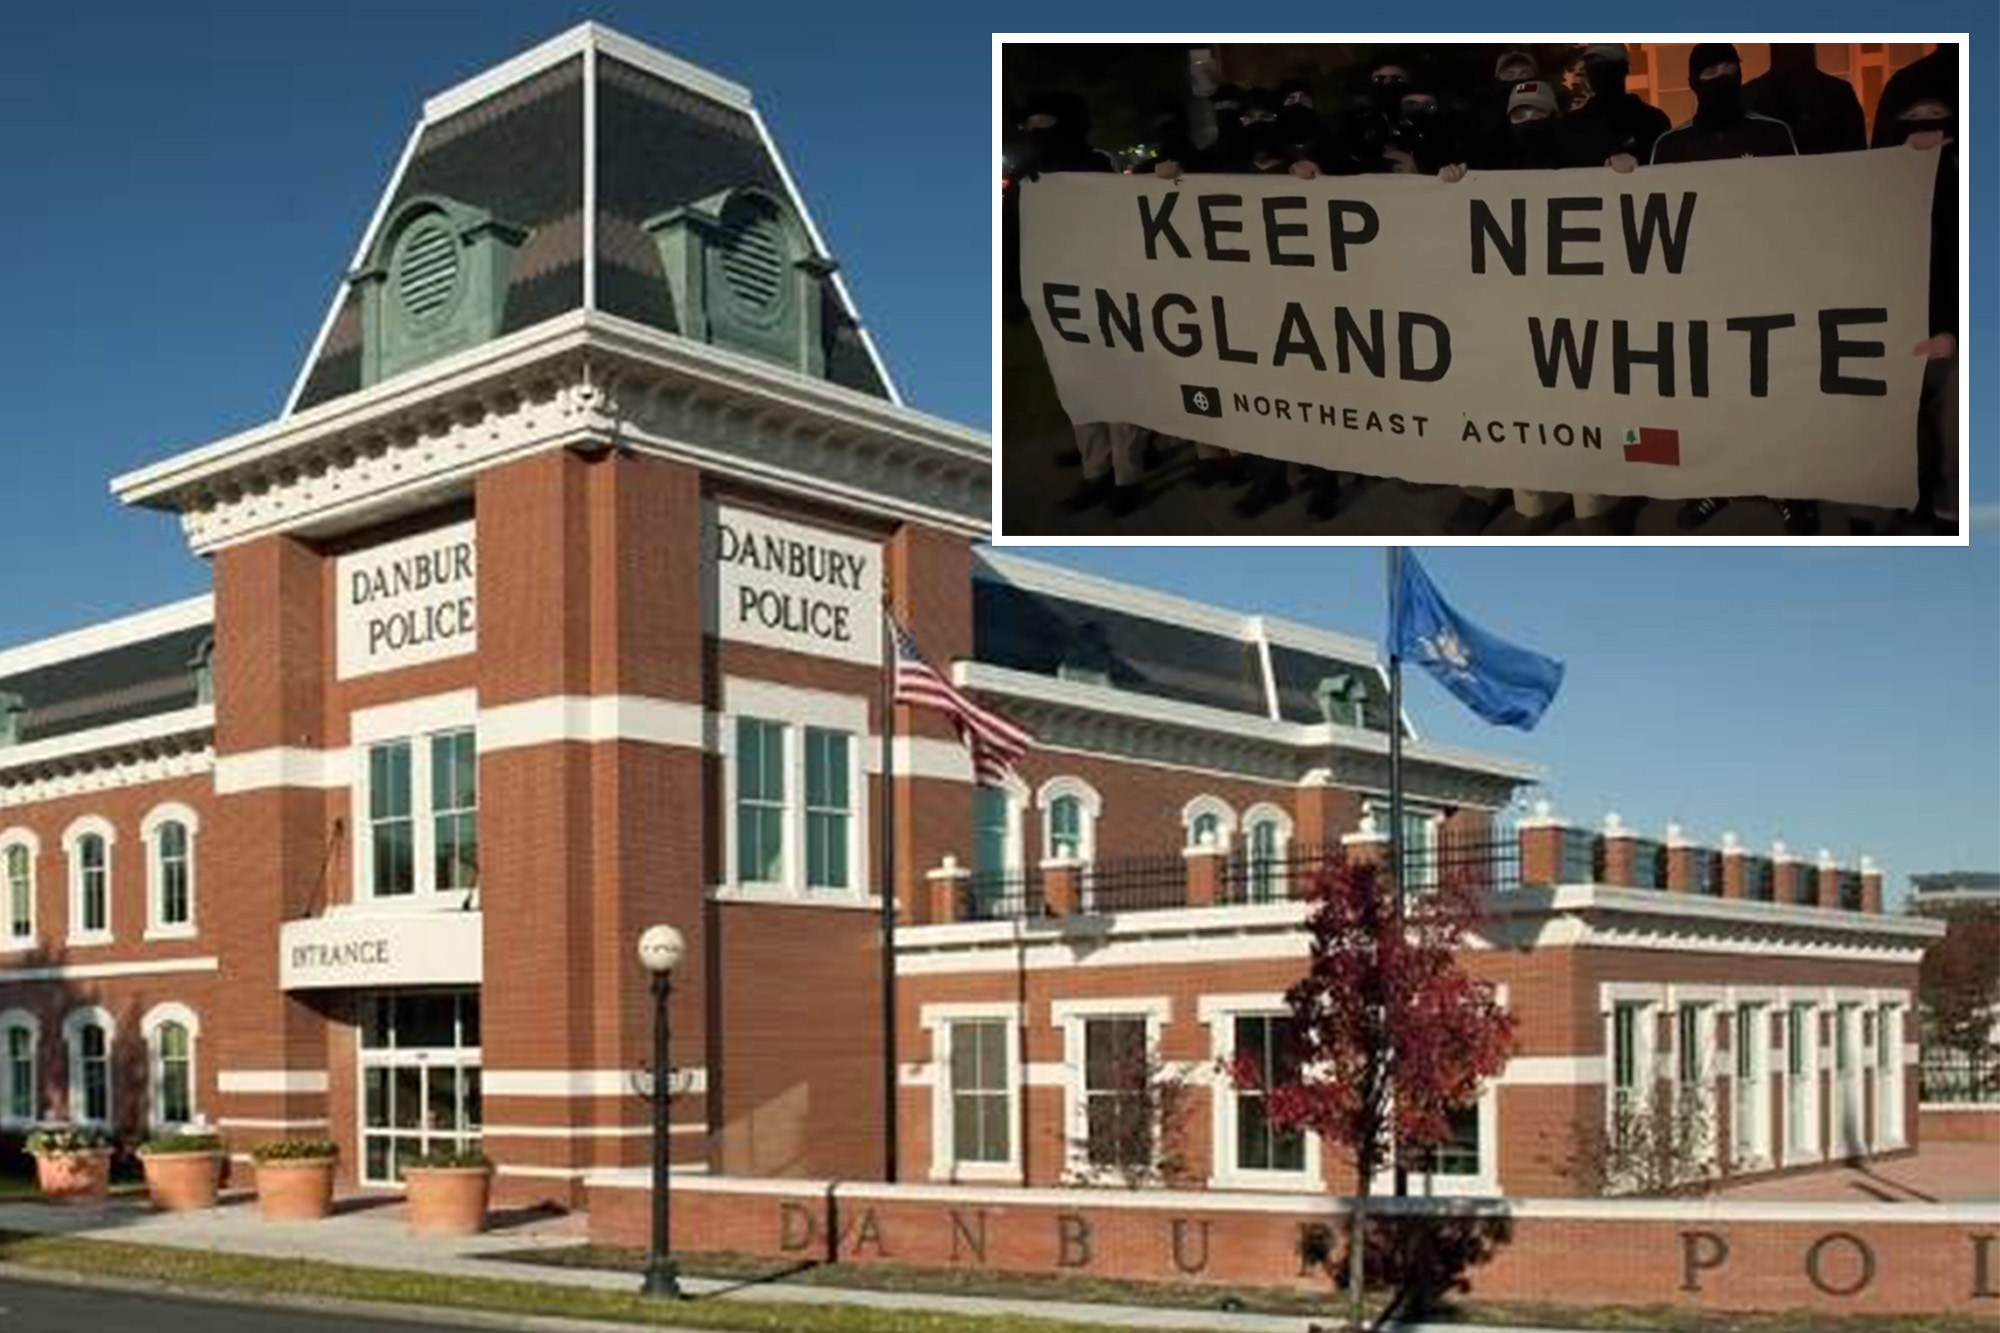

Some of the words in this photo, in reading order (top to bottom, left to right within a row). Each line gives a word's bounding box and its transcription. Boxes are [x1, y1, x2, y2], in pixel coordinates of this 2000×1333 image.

[1137, 192, 1380, 271] KEEP
[1470, 192, 1697, 276] NEW
[1043, 281, 1452, 382] ENGLAND
[1528, 307, 1888, 397] WHITE
[1233, 394, 1428, 437] NORTHEAST
[1461, 419, 1602, 449] ACTION
[717, 524, 866, 591] DANBURY
[369, 596, 475, 656] POLICE
[739, 585, 851, 642] POLICE
